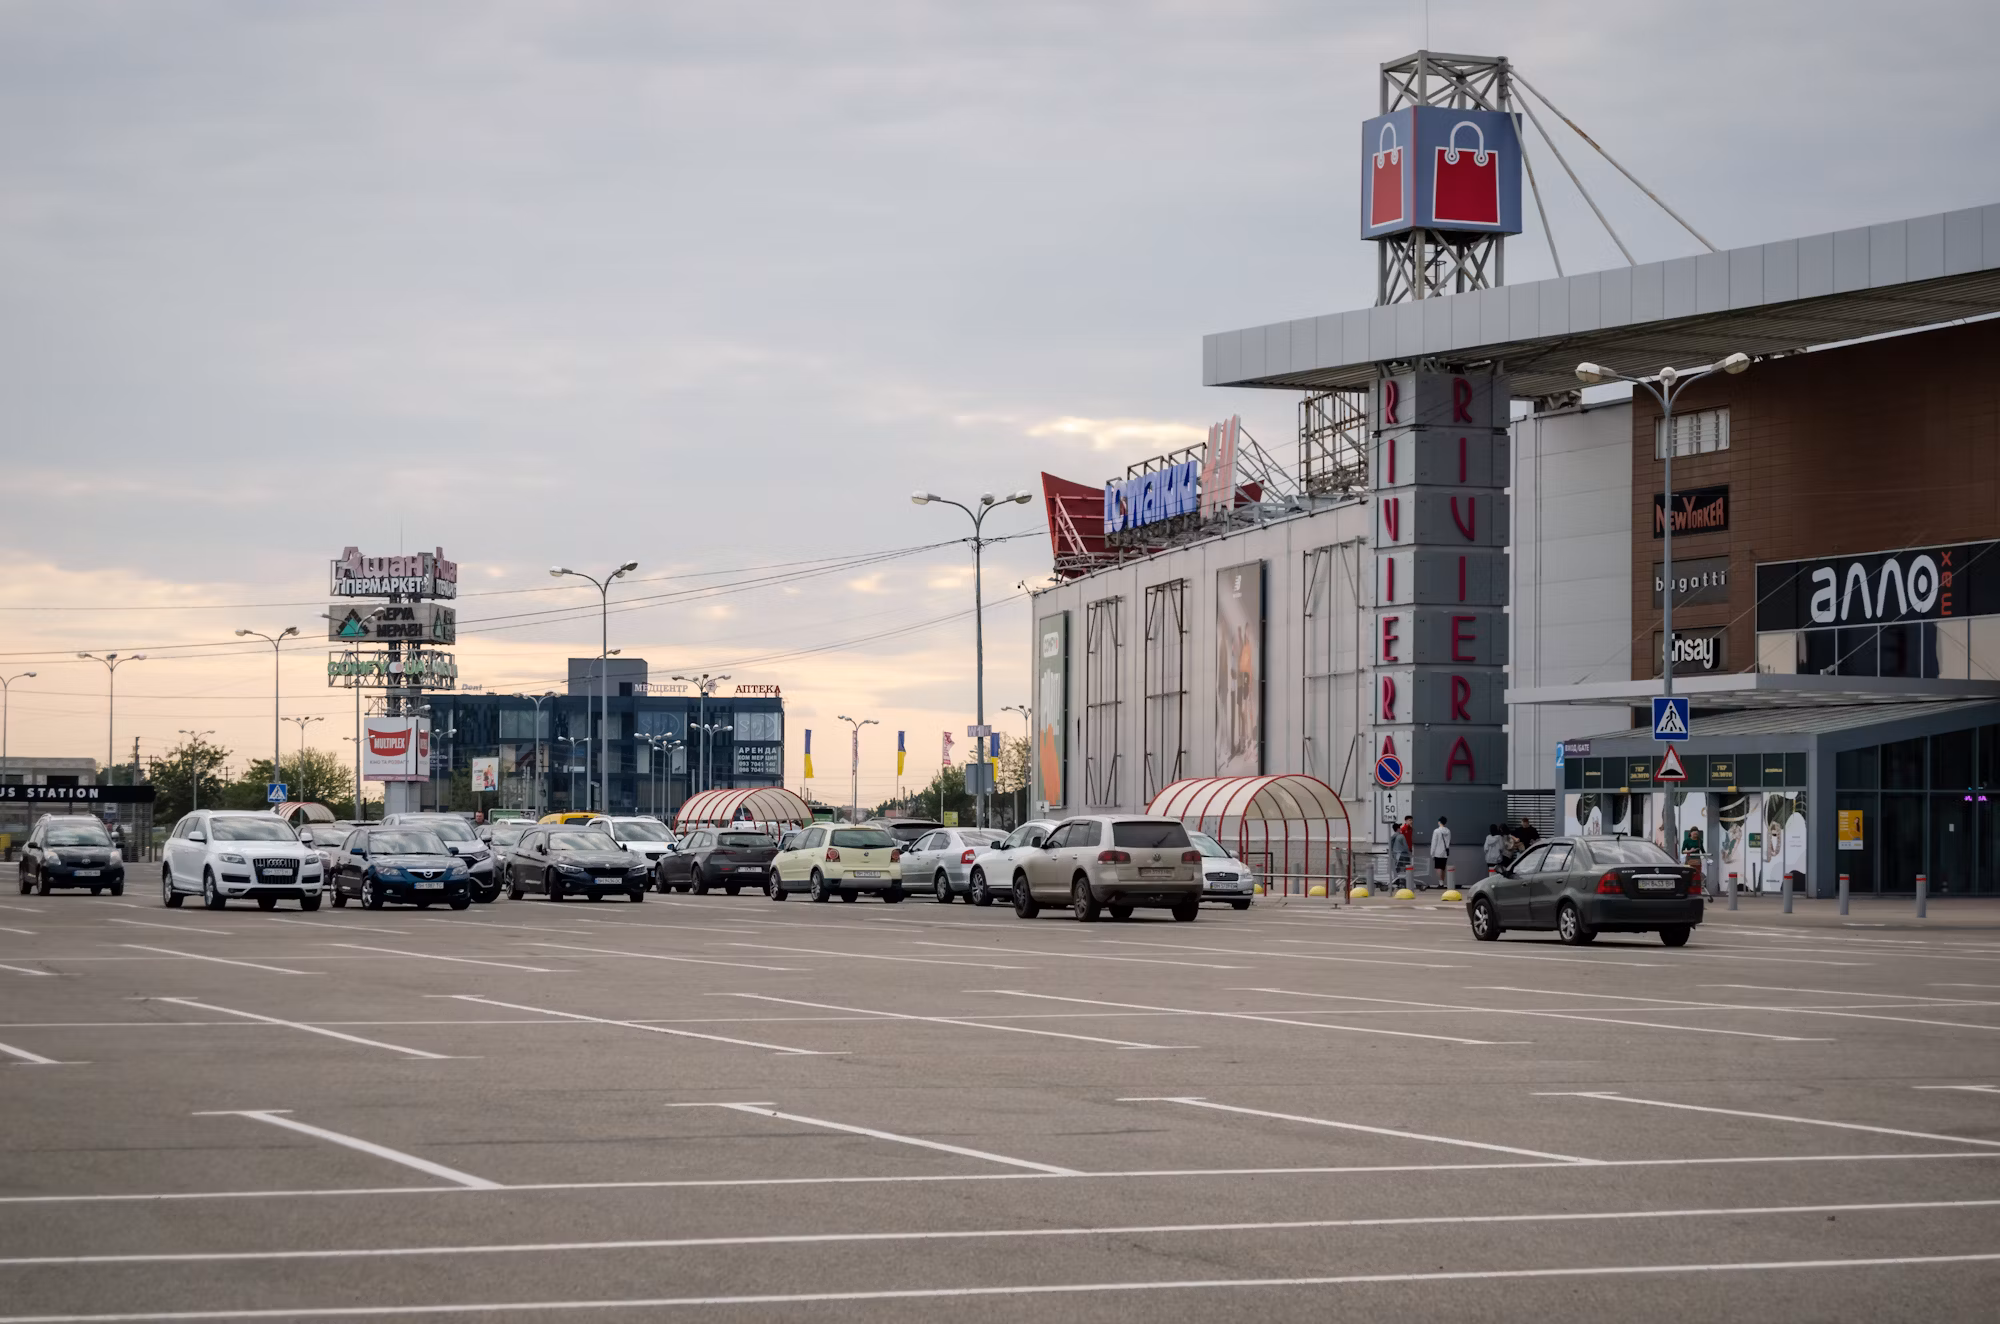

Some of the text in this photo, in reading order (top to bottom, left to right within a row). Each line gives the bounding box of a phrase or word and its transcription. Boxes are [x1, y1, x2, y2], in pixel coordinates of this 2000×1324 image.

[336, 547, 424, 578] Ашан
[1446, 377, 1476, 782] RIVIERA
[377, 624, 422, 637] МЕРЛЕН
[328, 661, 389, 676] COMFY
[635, 683, 688, 693] МЕДЦЕНТР
[735, 685, 781, 694] АПТЕКА
[374, 737, 405, 749] MULTIPLEX
[738, 747, 777, 755] АРЕНДА
[1556, 743, 1564, 767] 2
[27, 787, 99, 799] STATION
[1385, 804, 1396, 813] 50
